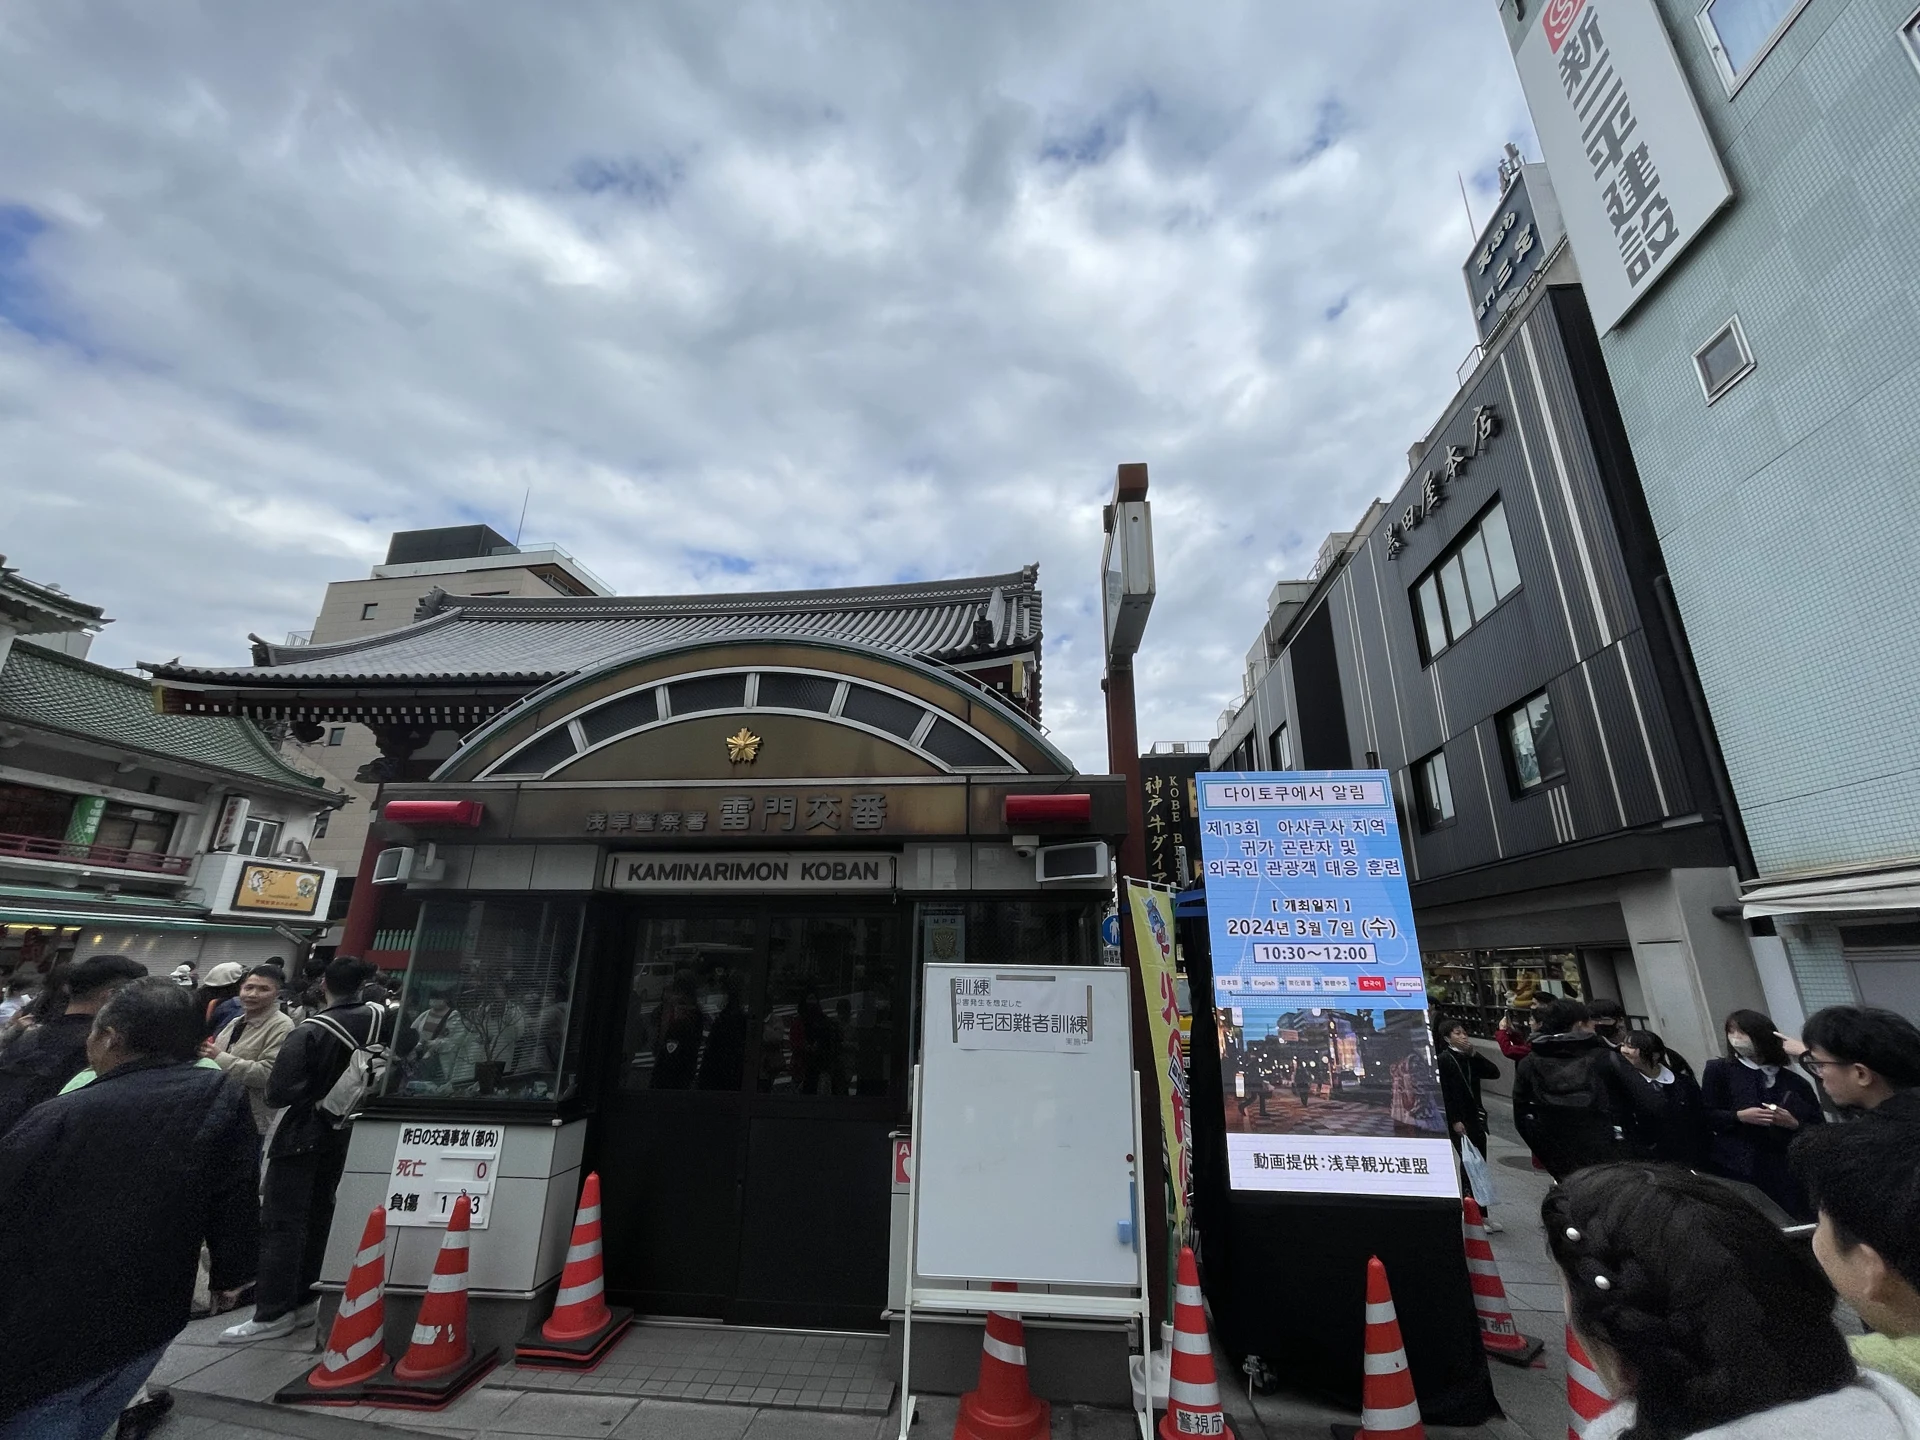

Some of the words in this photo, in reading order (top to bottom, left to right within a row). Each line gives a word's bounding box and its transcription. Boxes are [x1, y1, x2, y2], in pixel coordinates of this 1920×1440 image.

[1558, 5, 1680, 288] 新三平建設
[1477, 212, 1516, 275] 天ぷら
[1497, 223, 1533, 290] 三定
[1169, 776, 1181, 822] KOBE
[1224, 785, 1325, 802] 다이토쿠에서
[1332, 784, 1366, 800] 알림
[585, 811, 708, 832] 浅草警察署
[718, 793, 887, 831] 雷門交番
[1207, 820, 1260, 836] 제13회
[1278, 820, 1345, 836] 아사쿠사
[1353, 819, 1387, 836] 지역
[1241, 840, 1274, 857] 귀가
[1282, 840, 1332, 856] 곤란자
[1340, 839, 1357, 856] 및
[627, 862, 788, 882] KAMINARIMON
[801, 861, 879, 881] KOBAN
[1209, 860, 1260, 877] 외국인
[1266, 860, 1317, 877] 관광객
[1325, 860, 1359, 877] 대응
[1367, 859, 1401, 876] 훈련
[1228, 919, 1289, 936] 2024년
[1296, 919, 1321, 936] 3월
[1328, 919, 1355, 936] 7일
[1361, 917, 1396, 938] (수)
[956, 978, 989, 996] 訓練
[1254, 979, 1275, 987] English
[1363, 980, 1382, 988] 한국어
[957, 1011, 1088, 1035] 帰宅困難者訓練
[402, 1128, 499, 1147] 昨日の交通事故(都内)
[396, 1159, 427, 1177] 死亡
[477, 1162, 487, 1178] 0
[1253, 1152, 1430, 1175] 動画提供:浅草観光連盟
[388, 1192, 419, 1212] 負傷
[441, 1195, 480, 1214] 13
[1178, 1410, 1222, 1434] 警視庁
